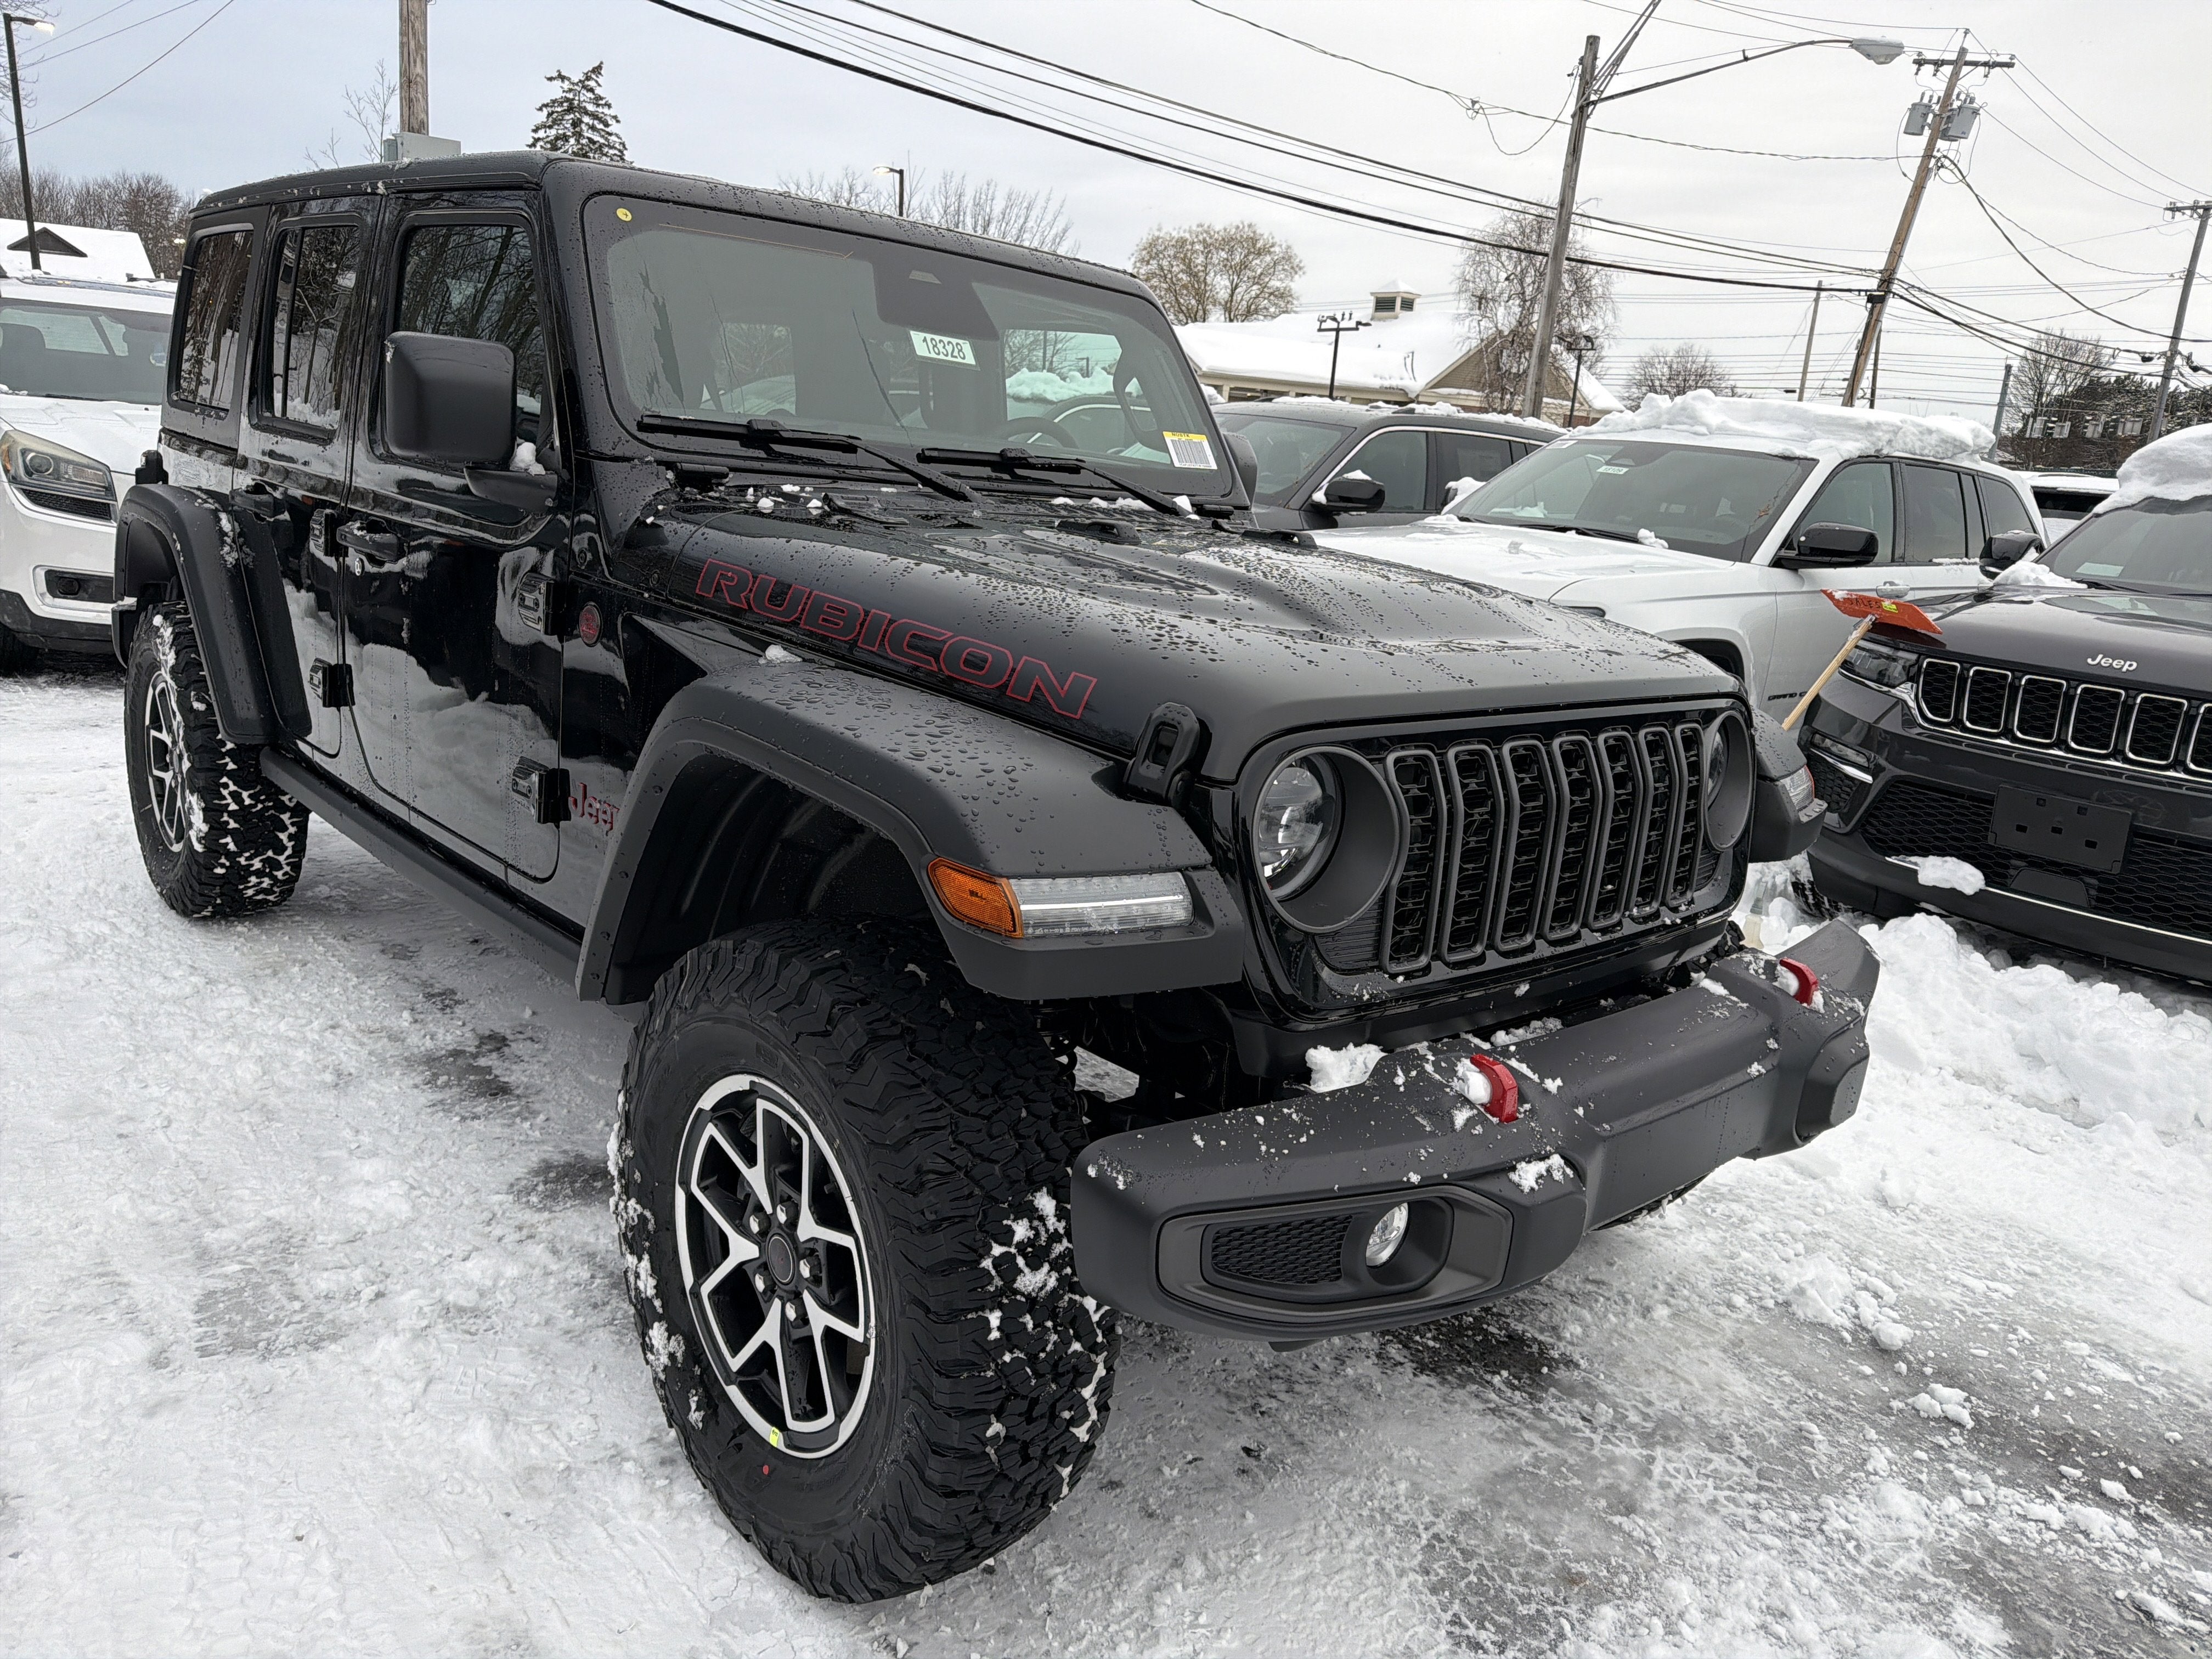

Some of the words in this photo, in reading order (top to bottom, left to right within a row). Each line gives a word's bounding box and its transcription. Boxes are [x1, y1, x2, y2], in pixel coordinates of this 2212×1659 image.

[922, 336, 966, 360] 18328
[695, 558, 1097, 719] RUBICON
[2087, 654, 2137, 672] Jeep
[1767, 692, 1798, 701] GRAND
[568, 782, 620, 832] Jee
